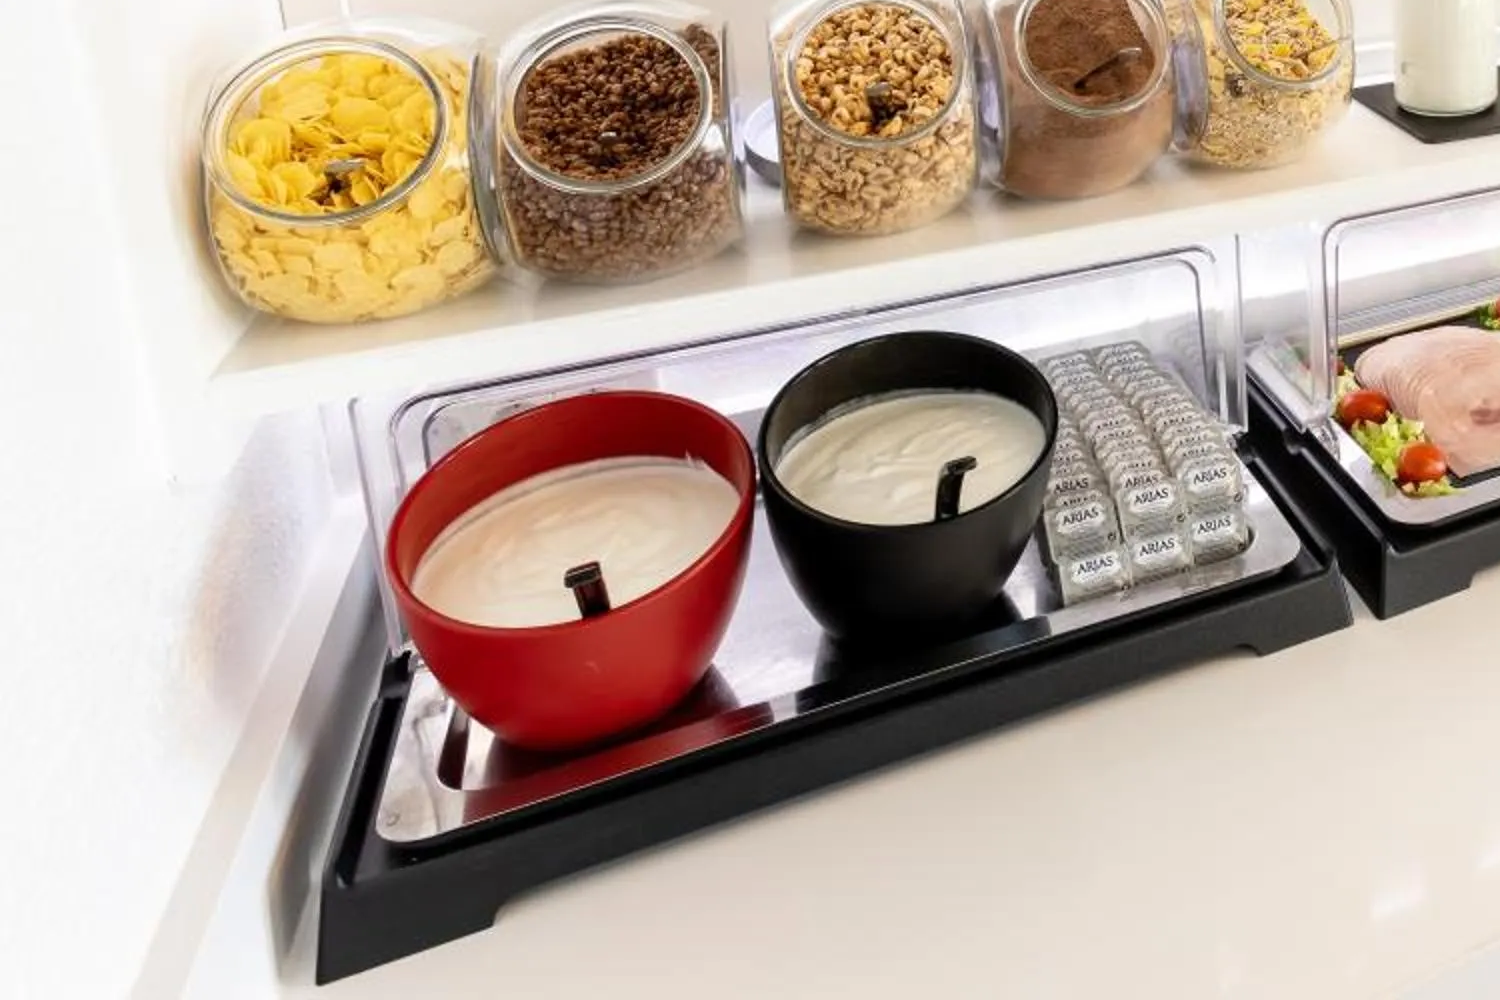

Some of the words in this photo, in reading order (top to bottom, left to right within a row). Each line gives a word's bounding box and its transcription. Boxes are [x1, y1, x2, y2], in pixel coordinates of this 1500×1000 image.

[1125, 473, 1159, 488] ARIAS
[1193, 467, 1227, 484] ARIAS
[1055, 478, 1088, 495] ARIAS
[1134, 487, 1169, 504] ARIAS
[1063, 507, 1099, 525] ARIAS
[1197, 515, 1232, 534] ARIAS
[1139, 537, 1175, 556] ARIAS
[1077, 556, 1114, 575] ARIAS
